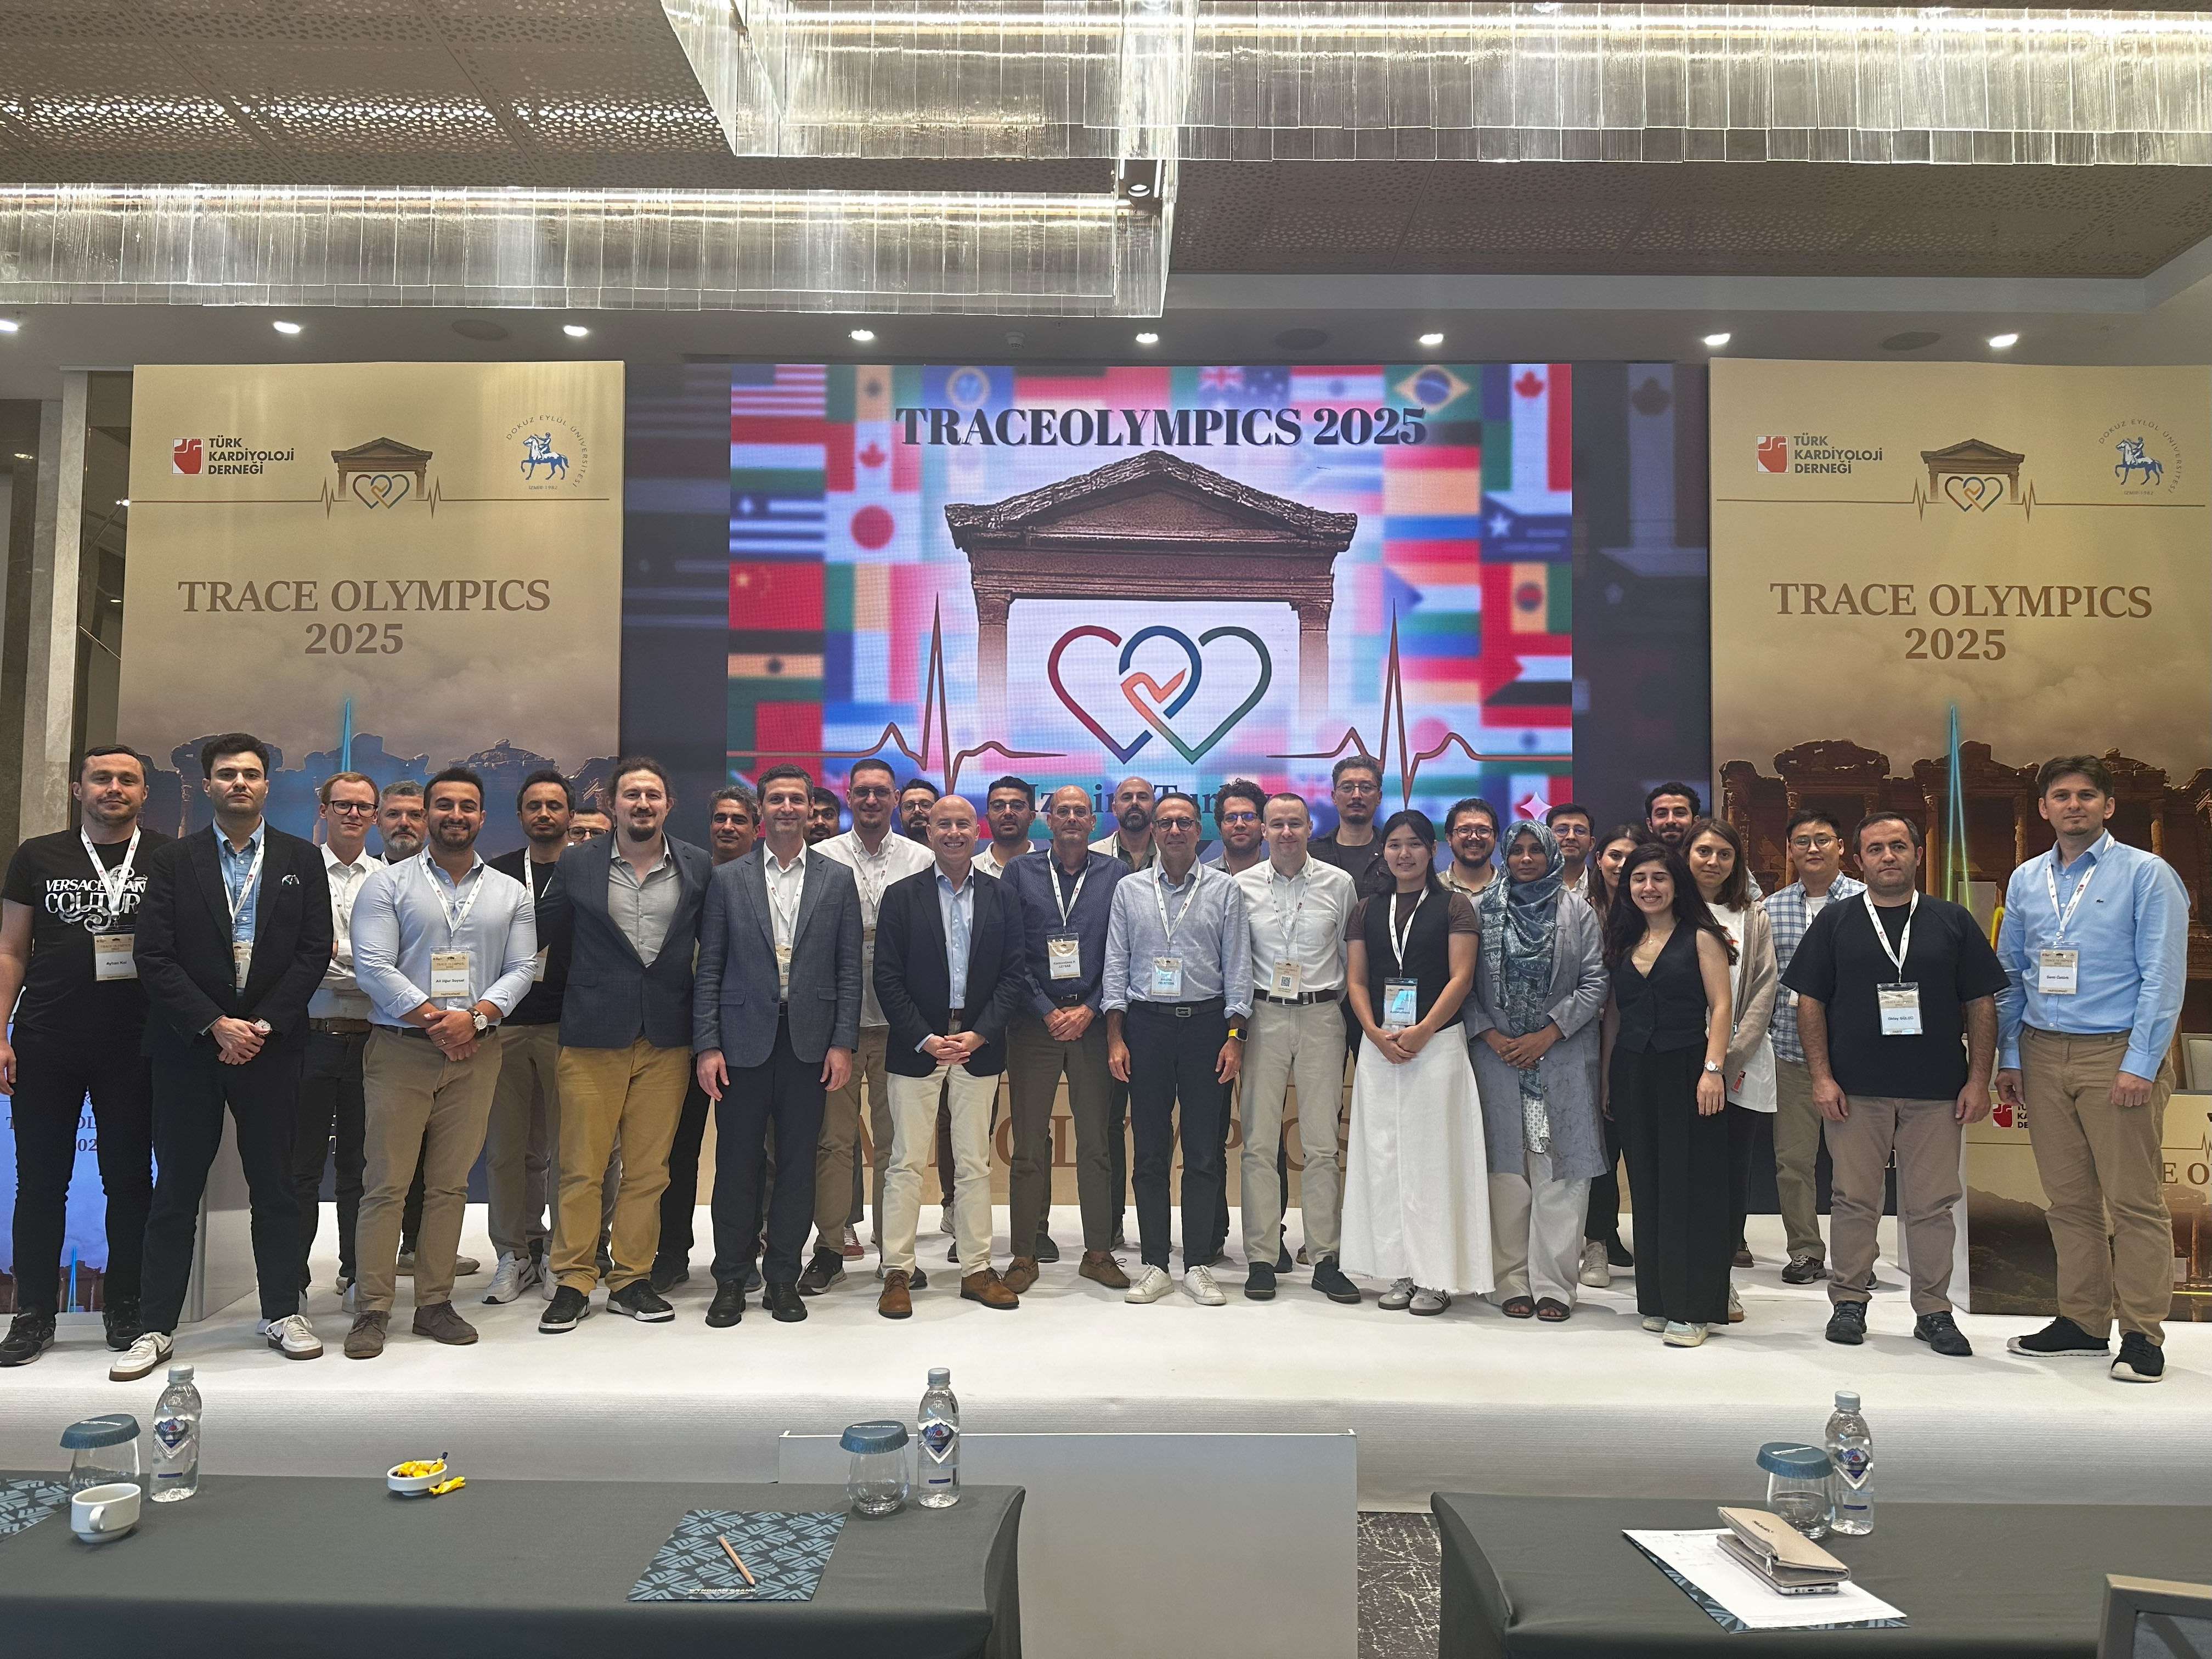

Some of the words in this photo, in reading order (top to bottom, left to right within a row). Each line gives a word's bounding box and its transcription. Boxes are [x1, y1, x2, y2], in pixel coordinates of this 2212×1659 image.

[506, 416, 535, 441] DOKUZ
[895, 407, 1303, 447] TRACEOLYMPICS
[1314, 407, 1426, 447] 2025
[208, 435, 242, 448] TÜRK
[1793, 432, 1829, 446] TÜRK
[208, 447, 295, 461] KARDİYOLOJİ
[1795, 446, 1882, 461] KARDİYOLOJİ
[208, 461, 264, 475] DERNEĞİ
[1795, 460, 1852, 474] DERNEĞİ
[178, 580, 318, 612] TRACE
[331, 579, 550, 612] OLYMPICS
[1770, 583, 1916, 616] TRACE
[1929, 584, 2152, 619] OLYMPICS
[304, 623, 403, 654] 2025
[1905, 628, 2006, 661] 2025
